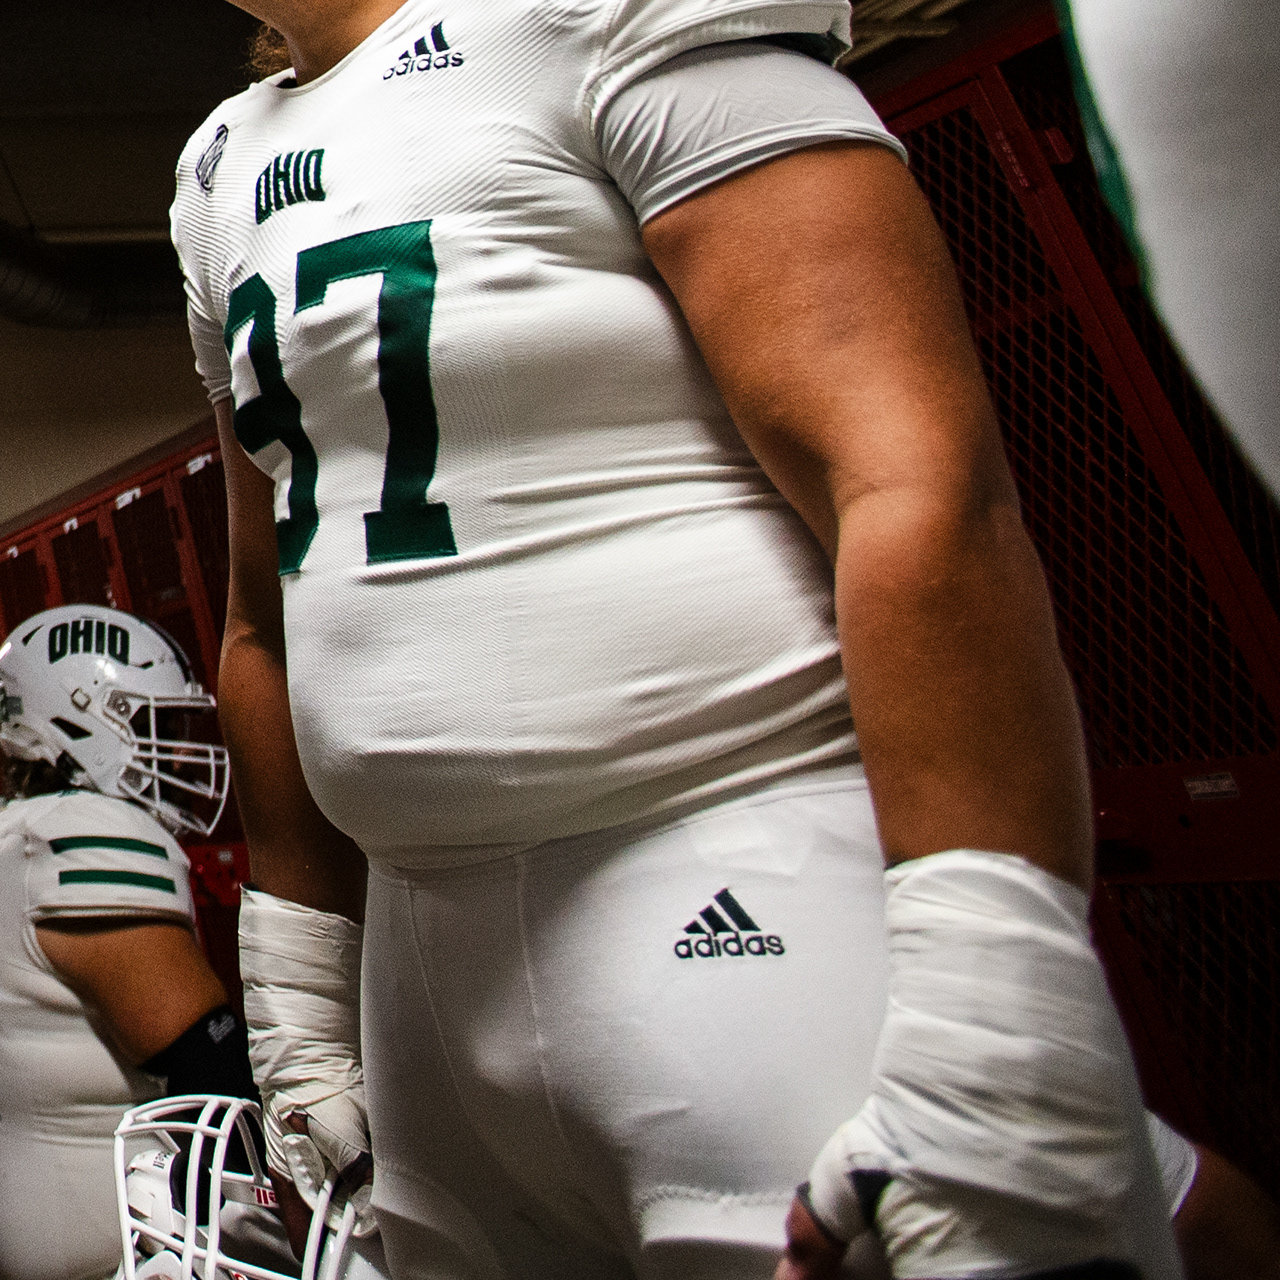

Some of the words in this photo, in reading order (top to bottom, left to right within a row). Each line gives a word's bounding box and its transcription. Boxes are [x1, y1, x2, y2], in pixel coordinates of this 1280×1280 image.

[383, 52, 465, 81] adidas
[255, 148, 327, 225] OHIO
[224, 218, 458, 576] 97
[48, 619, 130, 665] OHIO
[673, 931, 786, 960] adidas
